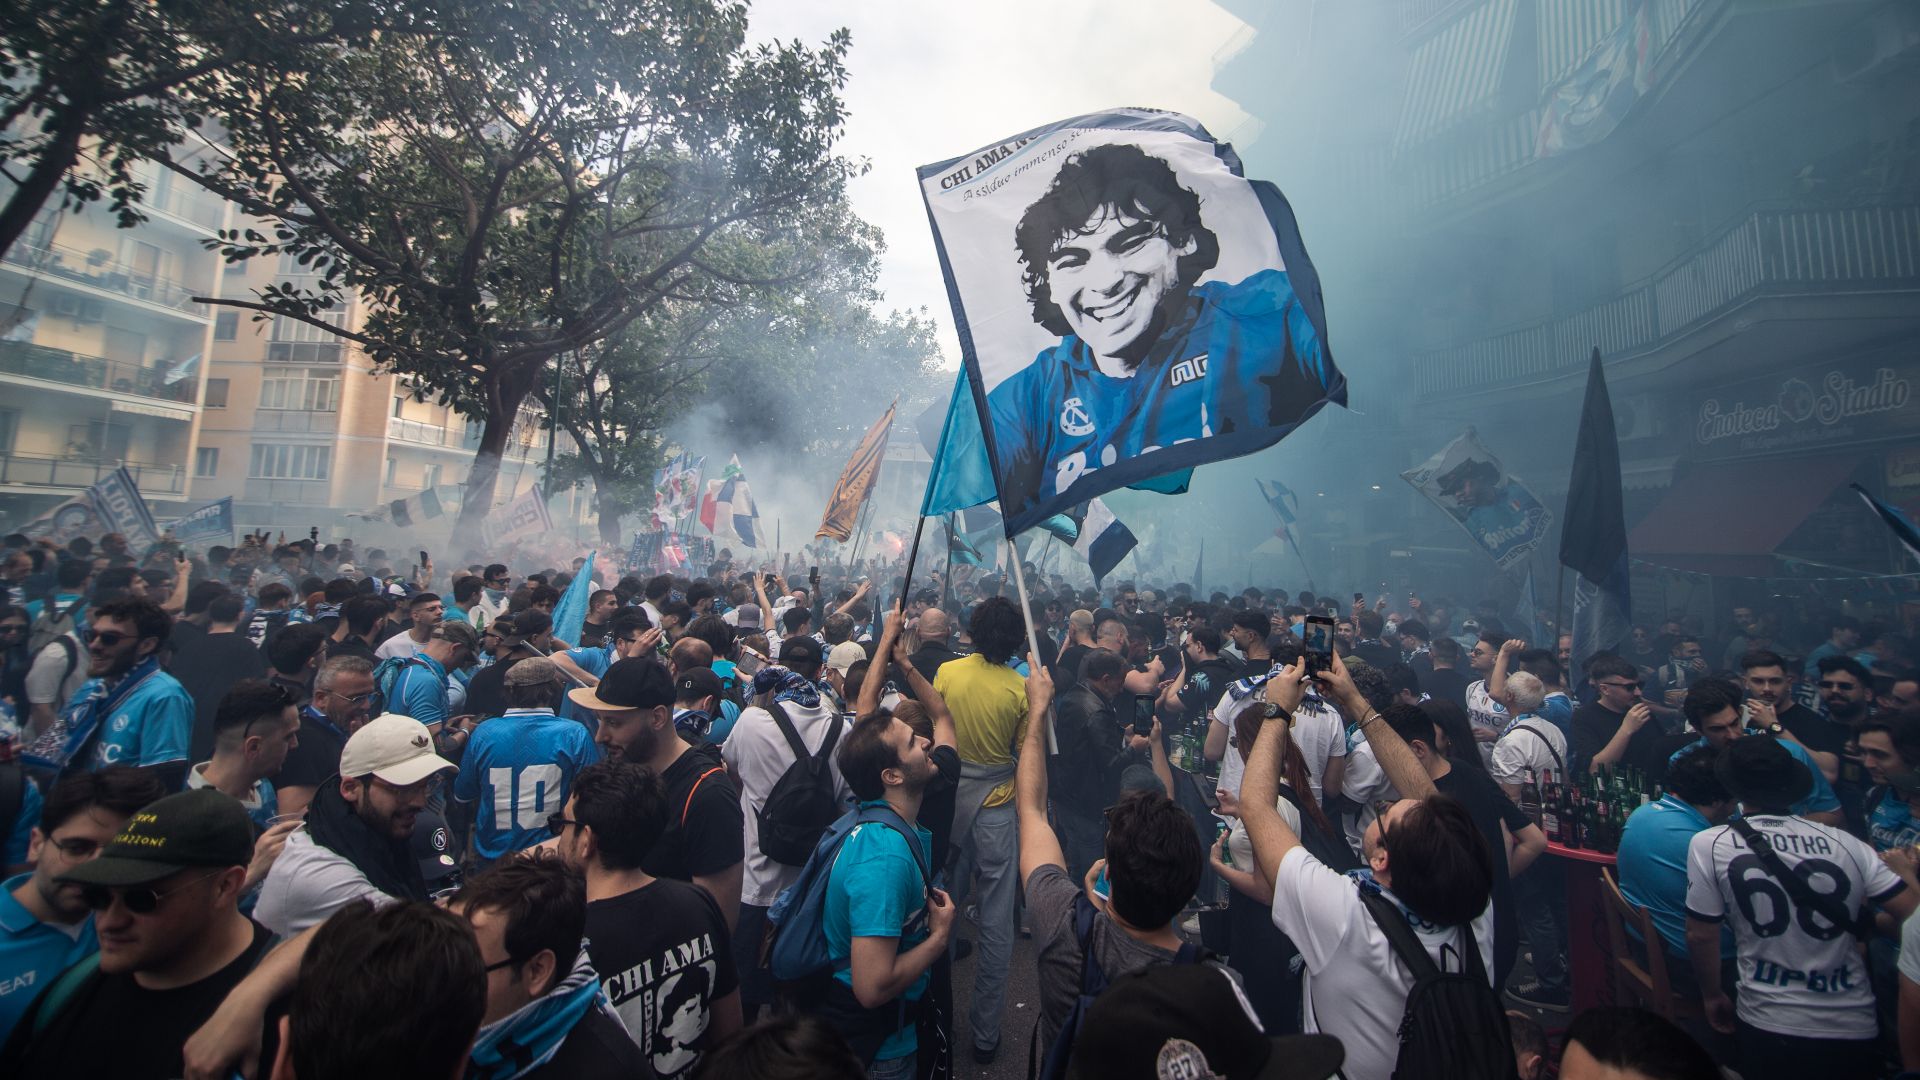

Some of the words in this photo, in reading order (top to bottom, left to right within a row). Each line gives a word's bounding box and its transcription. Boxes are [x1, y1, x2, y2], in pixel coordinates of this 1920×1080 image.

[941, 166, 973, 190] CHI
[976, 144, 1014, 174] AMA
[963, 174, 1011, 202] Assiduo
[1014, 139, 1068, 177] immenso
[1697, 399, 1780, 445] Enoteca
[1816, 368, 1911, 425] Stadio
[1472, 710, 1503, 727] MSC
[489, 763, 562, 830] 10
[1727, 852, 1852, 941] 68
[0, 969, 36, 996] EA7
[602, 958, 655, 1004] CHI
[660, 932, 715, 977] AMA
[644, 988, 654, 1056] DIEGO
